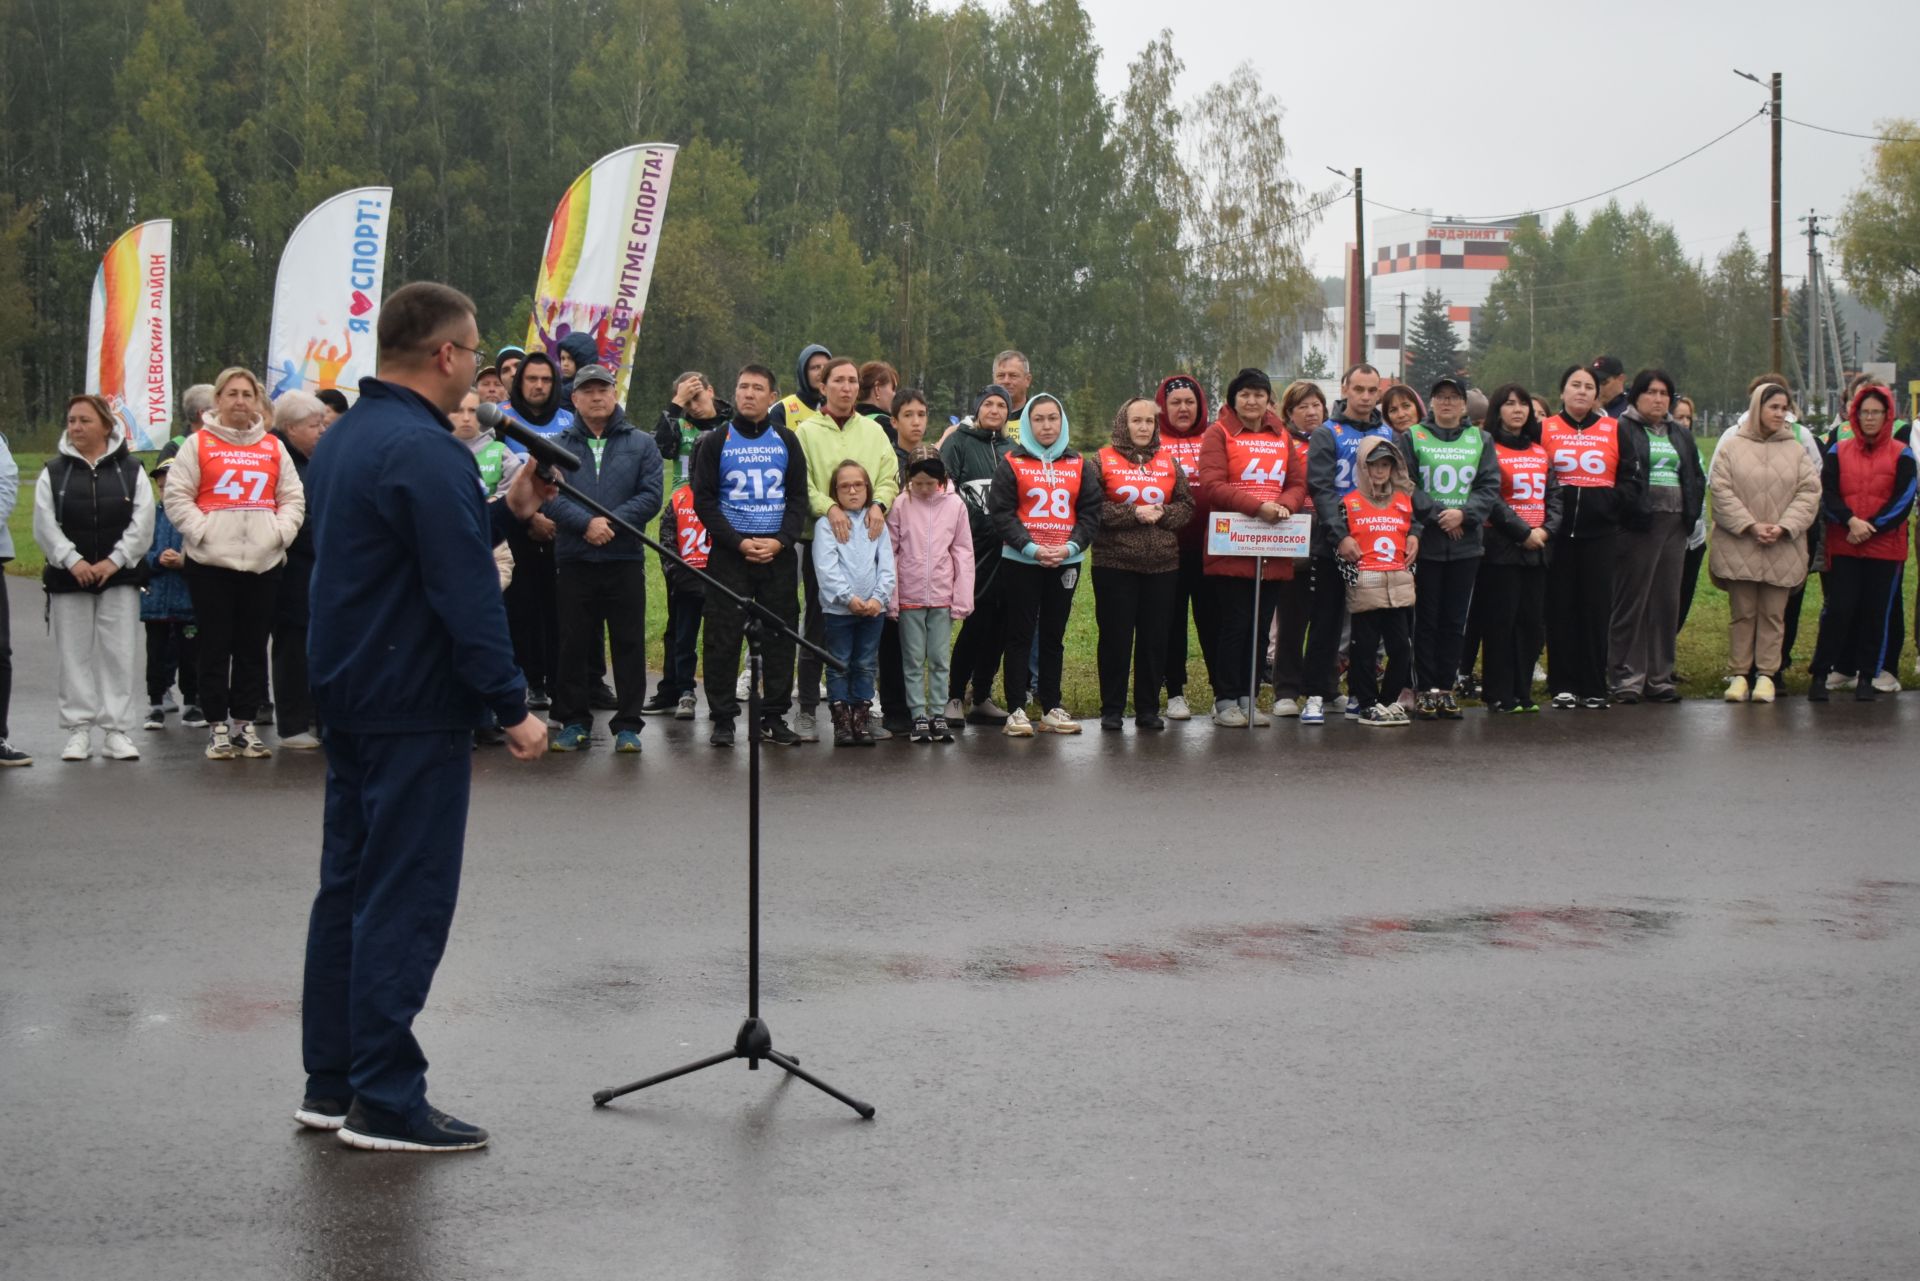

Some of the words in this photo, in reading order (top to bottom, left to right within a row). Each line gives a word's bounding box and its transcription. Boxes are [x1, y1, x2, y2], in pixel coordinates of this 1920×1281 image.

[631, 149, 665, 238] СПОРТА!
[351, 199, 383, 290] СПОРТ!
[615, 240, 648, 312] РИТМЕ
[348, 318, 370, 334] Я
[147, 316, 167, 426] ТУКАЕВСКИЙ
[723, 445, 784, 457] ТУКАЕВСКИЙ
[1236, 440, 1286, 449] ТУКАЕВСКИЙ
[1249, 447, 1277, 455] РАЙОН
[1420, 446, 1477, 455] ТУКАЕВСКИЙ
[208, 451, 272, 462] ТУКАЕВСКИЙ
[223, 458, 259, 466] РАЙОН
[738, 454, 772, 464] РАЙОН
[1553, 449, 1606, 475] 56
[1124, 474, 1157, 483] РАЙОН
[1240, 457, 1287, 488] 44
[1418, 464, 1477, 494] 109
[213, 469, 269, 501] 47
[725, 468, 784, 501] 212
[1511, 472, 1547, 500] 55
[1026, 487, 1070, 519] 28
[1115, 485, 1165, 506] 29
[1355, 516, 1405, 526] ТУКАЕВСКИЙ
[1369, 525, 1397, 533] РАЙОН
[1230, 532, 1306, 545] Иштеряковское
[1373, 536, 1397, 562] 9
